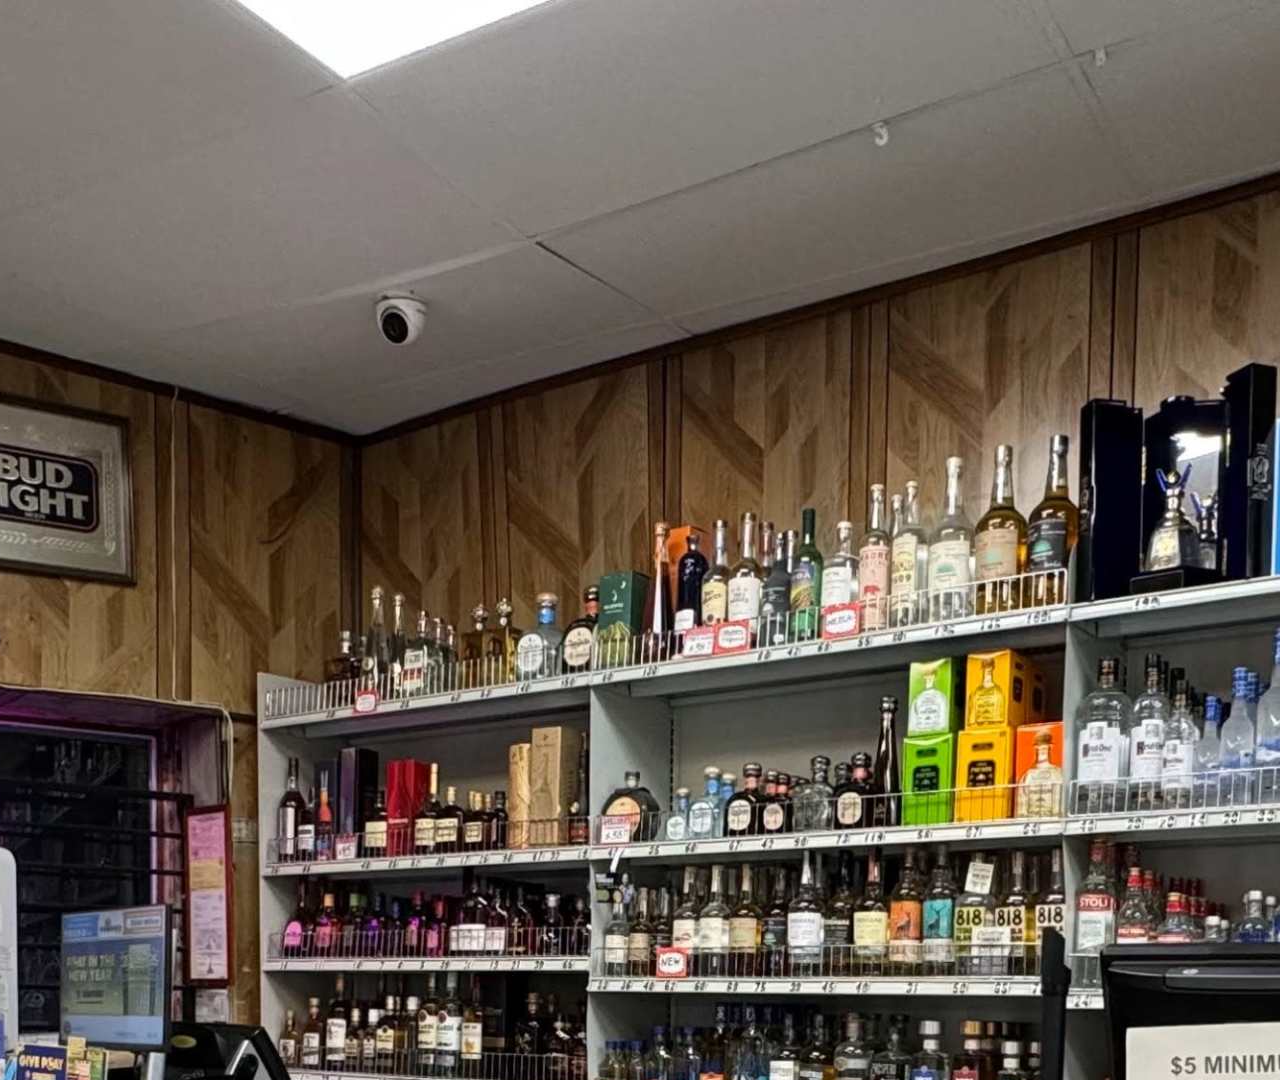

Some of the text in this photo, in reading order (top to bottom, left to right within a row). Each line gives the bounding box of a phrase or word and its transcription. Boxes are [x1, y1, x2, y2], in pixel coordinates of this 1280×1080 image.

[956, 908, 983, 927] 818
[995, 908, 1022, 927] 818
[1037, 905, 1064, 924] 818
[659, 955, 682, 968] NEW
[1169, 1056, 1197, 1077] $5
